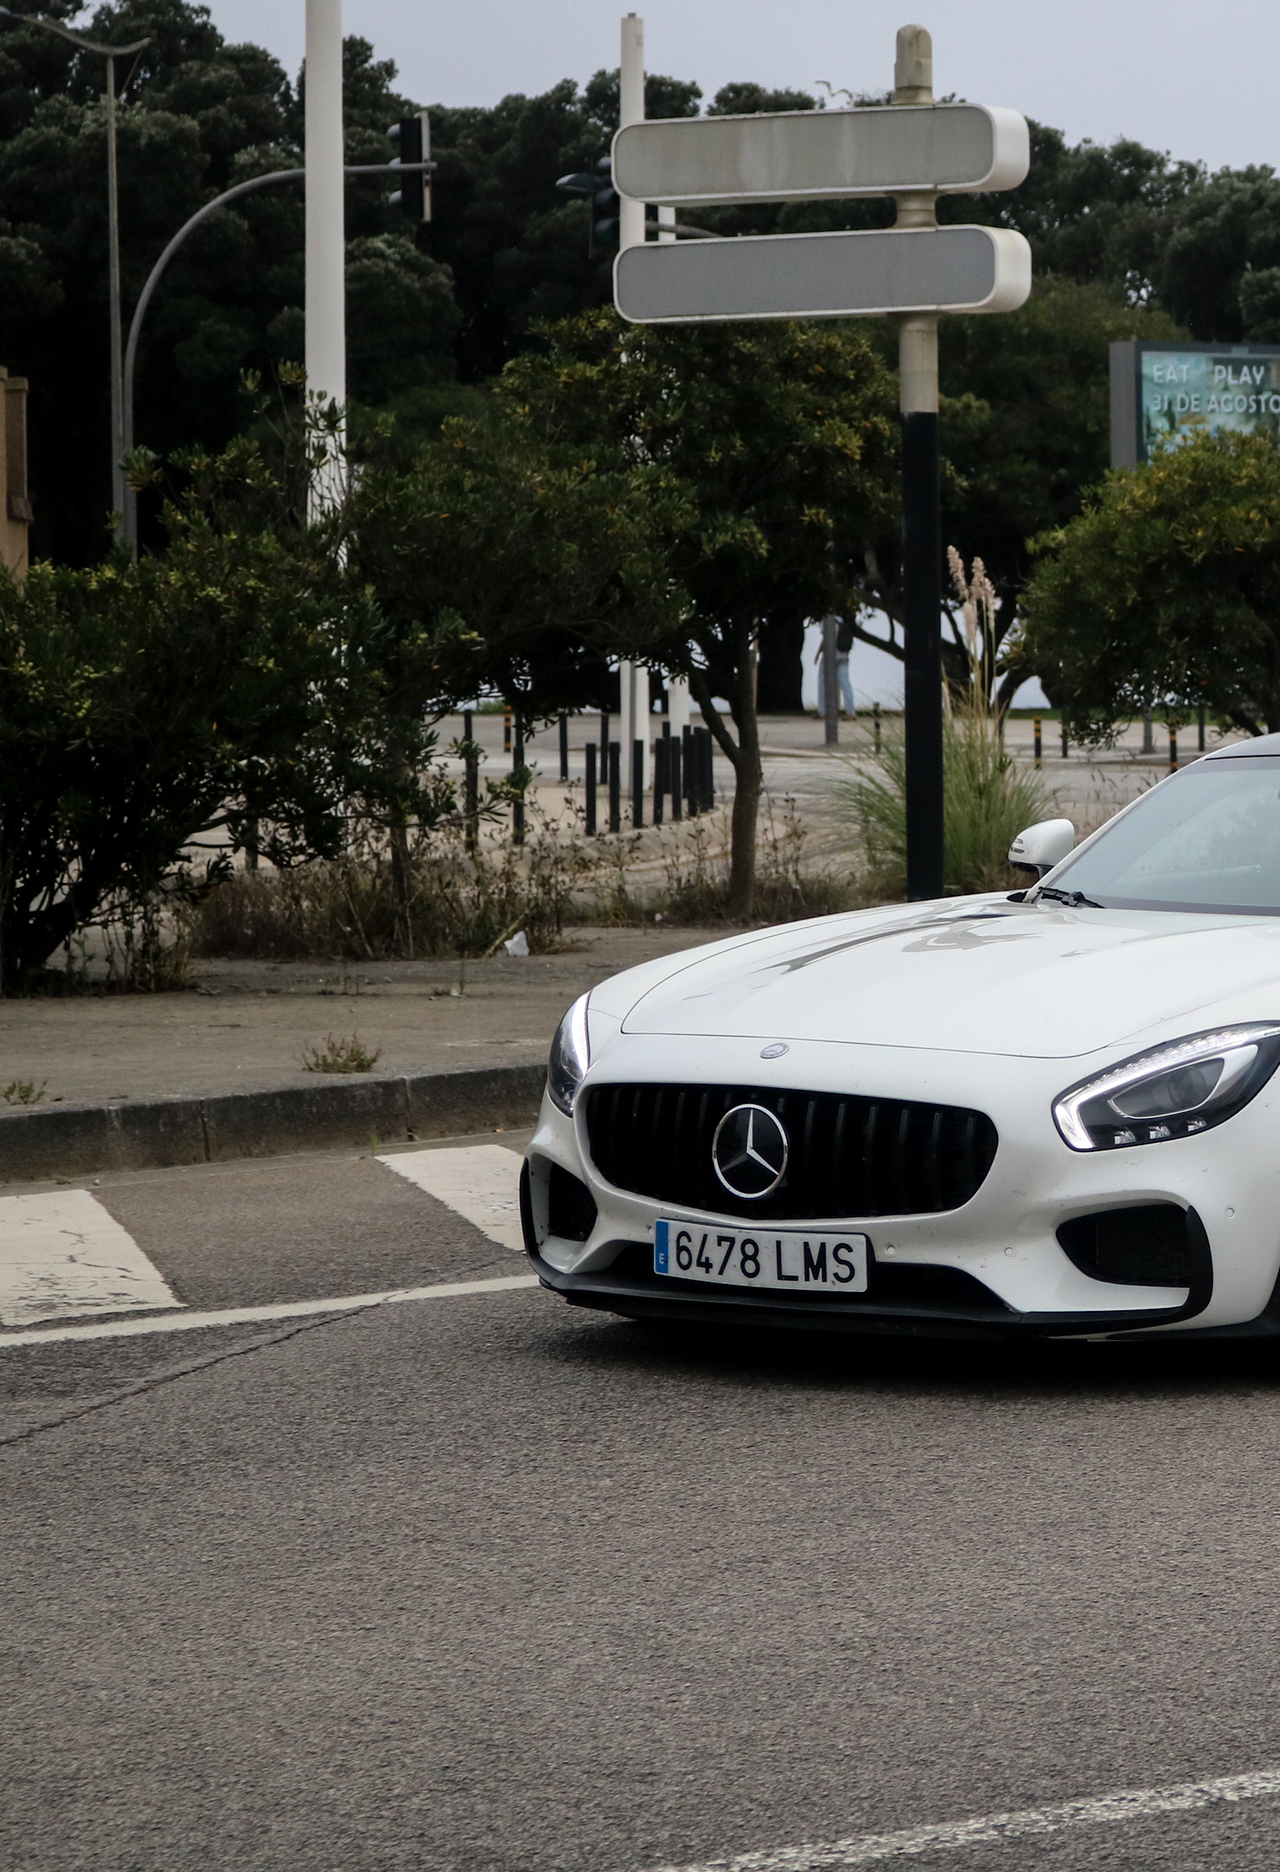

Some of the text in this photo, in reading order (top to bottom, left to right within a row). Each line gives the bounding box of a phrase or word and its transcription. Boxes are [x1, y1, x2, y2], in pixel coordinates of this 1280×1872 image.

[1152, 364, 1190, 383] EAT
[1214, 365, 1265, 384] PLAY
[1152, 394, 1169, 411] 31
[1176, 394, 1201, 412] DE
[659, 1253, 665, 1264] E
[675, 1230, 856, 1284] 6478 LMS
